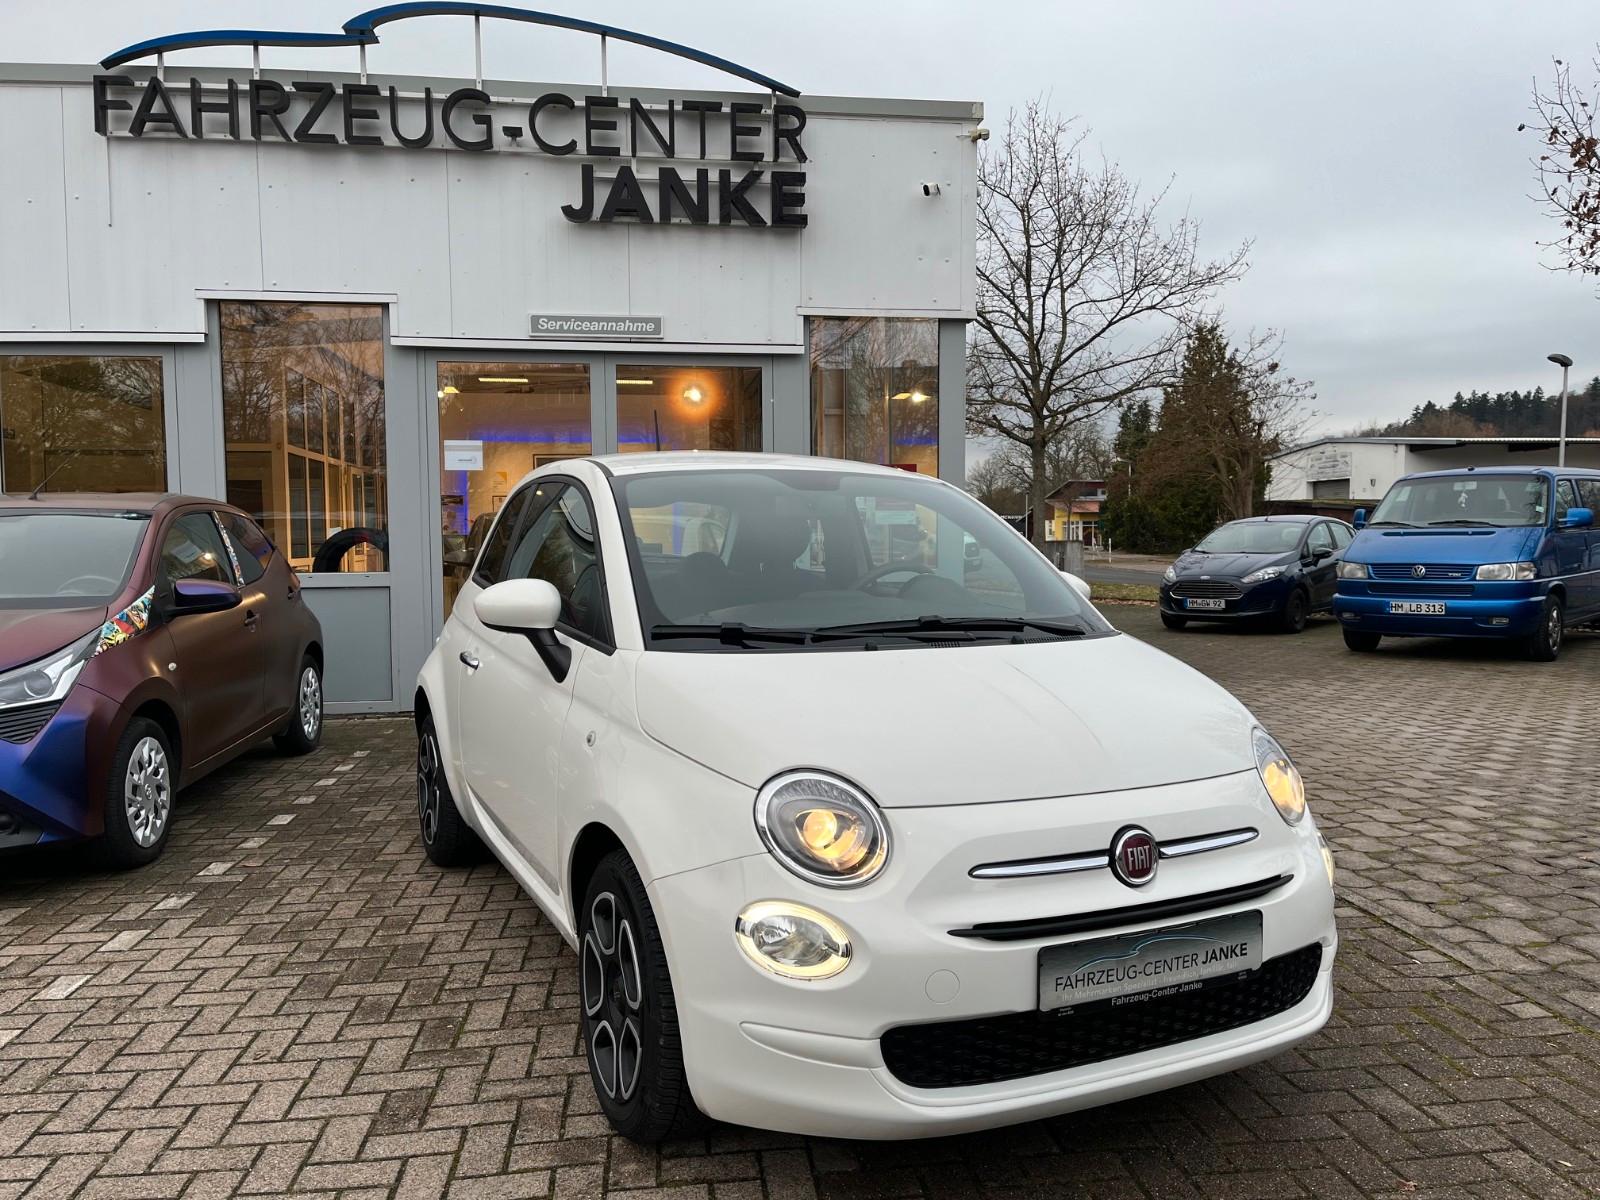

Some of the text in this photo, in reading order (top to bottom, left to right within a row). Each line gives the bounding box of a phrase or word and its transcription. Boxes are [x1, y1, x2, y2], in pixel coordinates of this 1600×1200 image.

[93, 75, 807, 163] FAHRZEUG-CENTER
[561, 163, 808, 229] JANKE
[537, 318, 655, 332] Serviceannahme
[1390, 602, 1444, 613] HM LB 313
[1127, 845, 1150, 871] FIAT
[1055, 953, 1199, 992] FAHRZEUG-CENTER
[1202, 942, 1248, 965] JANKE
[1111, 981, 1203, 1007] Fahrzeug-Center Janke
